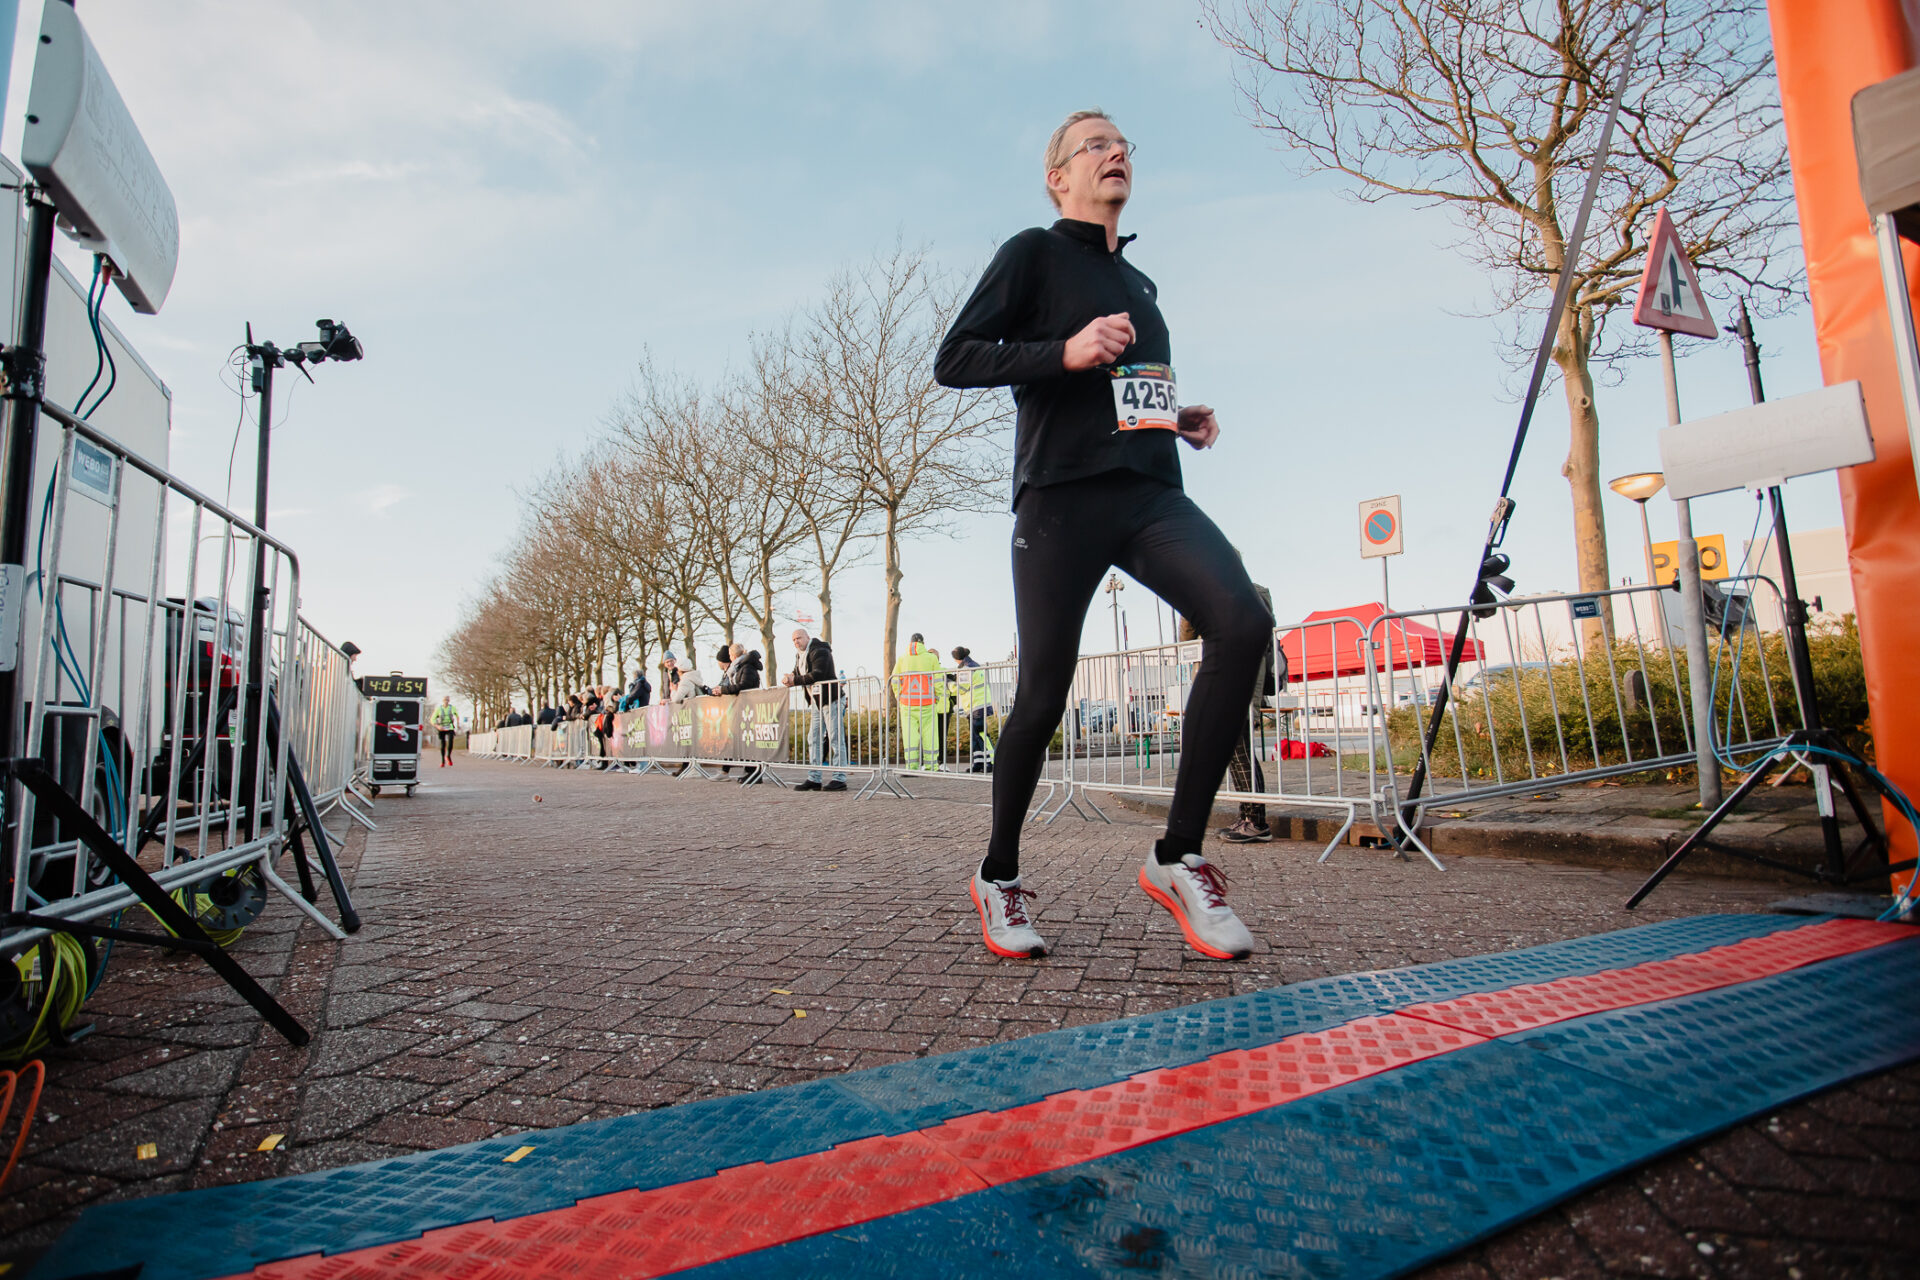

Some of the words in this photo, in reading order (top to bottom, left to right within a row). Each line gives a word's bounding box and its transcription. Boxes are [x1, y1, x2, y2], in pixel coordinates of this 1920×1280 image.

[1122, 381, 1176, 413] 4256
[77, 449, 101, 473] WEBO
[369, 680, 423, 693] 4:01:54
[755, 702, 780, 723] VALK
[755, 723, 780, 741] EVENT
